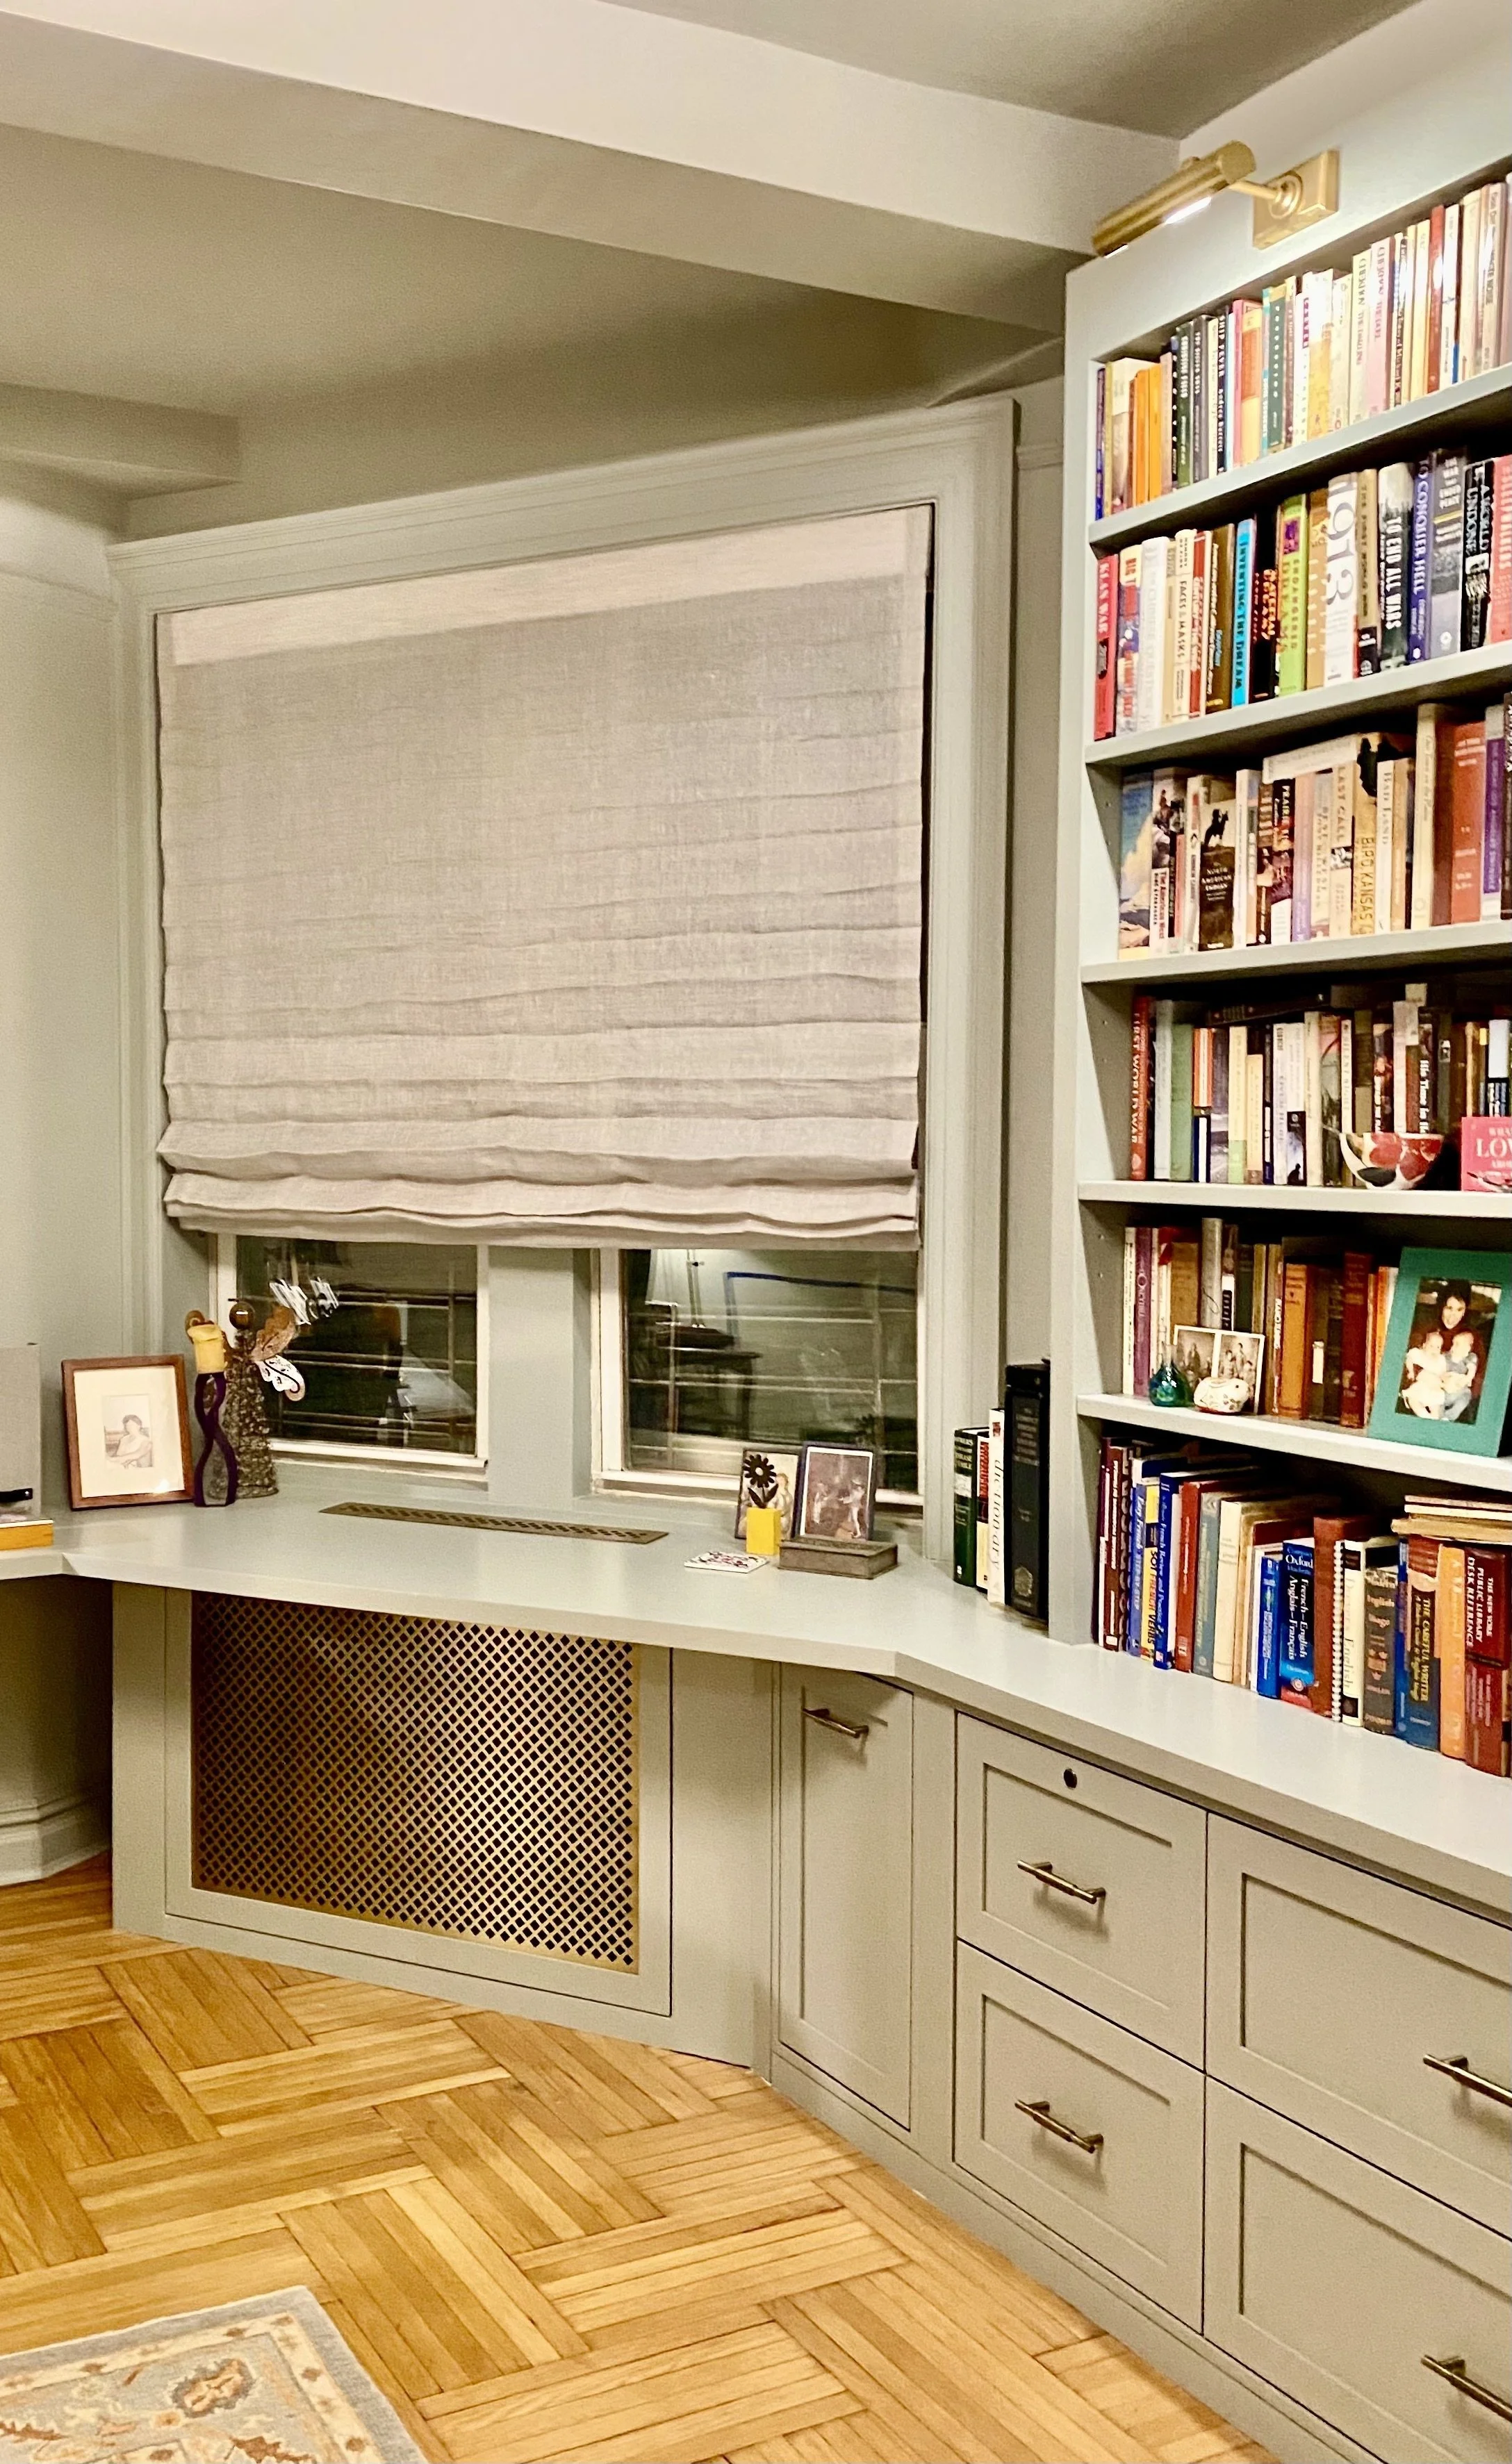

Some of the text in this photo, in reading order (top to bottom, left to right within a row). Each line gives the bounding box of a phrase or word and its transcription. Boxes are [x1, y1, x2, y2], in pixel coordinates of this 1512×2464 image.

[1326, 482, 1357, 606] 1913
[1413, 458, 1430, 595] TO CONQUER HELL
[1465, 486, 1479, 556] UNDONE
[1178, 580, 1188, 609] FACES
[1384, 516, 1402, 630] TO END ALL WARS
[1097, 561, 1110, 634] KLAN WAR
[1235, 540, 1250, 690] INVENTING THE DREAM
[1290, 559, 1299, 651] ENDANGERED
[1176, 620, 1188, 659] MASKS
[1337, 766, 1347, 843] LAST CALL
[1158, 871, 1167, 883] The
[1359, 872, 1374, 920] KANSAS
[1158, 886, 1167, 920] American
[1131, 1054, 1140, 1109] WORLD
[1131, 1112, 1140, 1145] WAR
[1135, 1496, 1145, 1516] Easy
[1135, 1519, 1145, 1550] French
[1159, 1523, 1167, 1548] French
[1158, 1550, 1166, 1575] Review
[1285, 1554, 1314, 1569] Oxford
[1148, 1573, 1158, 1611] FRENCH
[1156, 1594, 1165, 1624] Practice
[1465, 1556, 1477, 1648] DESK REFERENCE
[1475, 1566, 1485, 1644] PUBLIC LIBRARY
[1146, 1614, 1156, 1645] VERBS
[1420, 1598, 1432, 1702] THE CAREFUL WRITER
[1342, 1637, 1355, 1690] English
